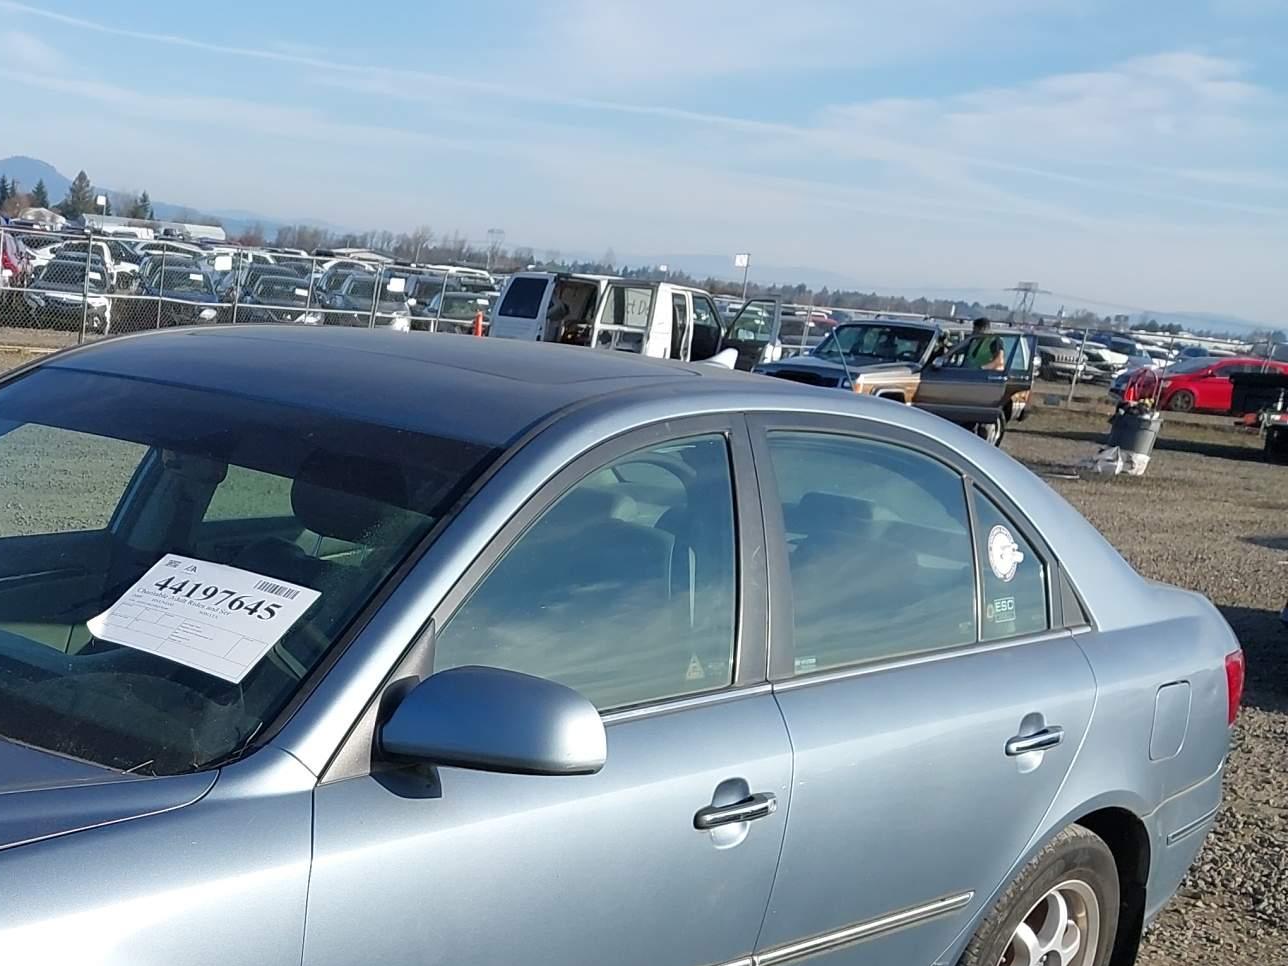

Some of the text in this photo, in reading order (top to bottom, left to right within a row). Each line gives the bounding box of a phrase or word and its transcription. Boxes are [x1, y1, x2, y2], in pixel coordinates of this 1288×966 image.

[154, 575, 283, 621] 44197645
[187, 598, 206, 609] Rides
[206, 603, 218, 612] and
